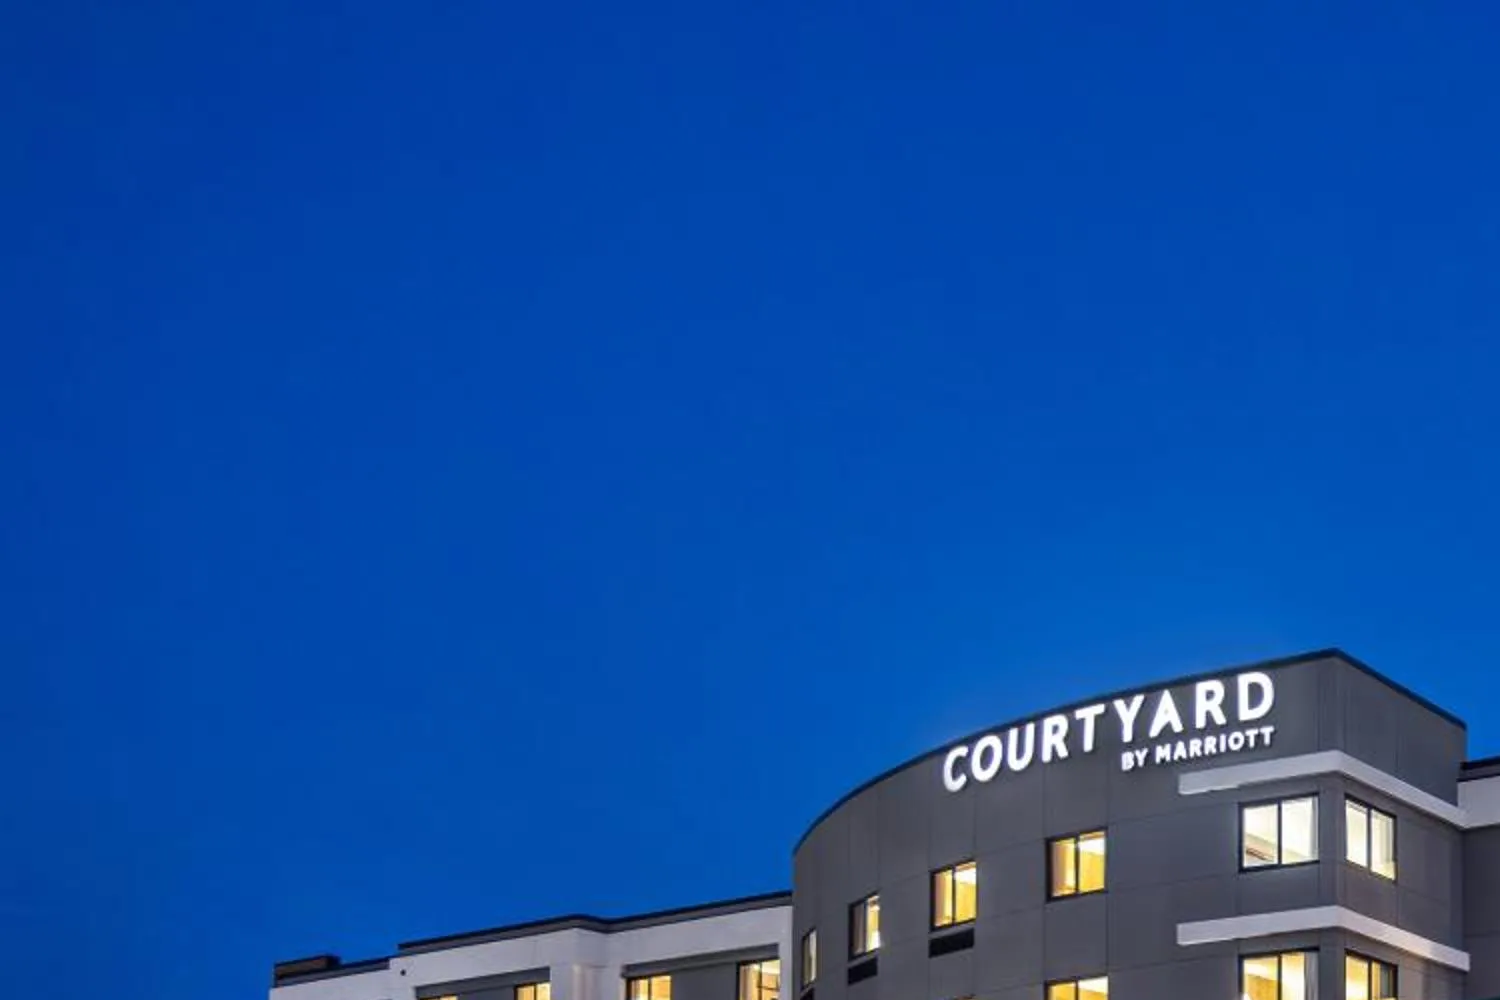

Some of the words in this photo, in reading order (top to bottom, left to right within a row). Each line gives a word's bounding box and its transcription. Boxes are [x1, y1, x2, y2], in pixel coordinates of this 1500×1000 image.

[942, 671, 1275, 793] COURTYARD
[1121, 748, 1149, 772] BY
[1154, 725, 1276, 765] MARRIOTT
